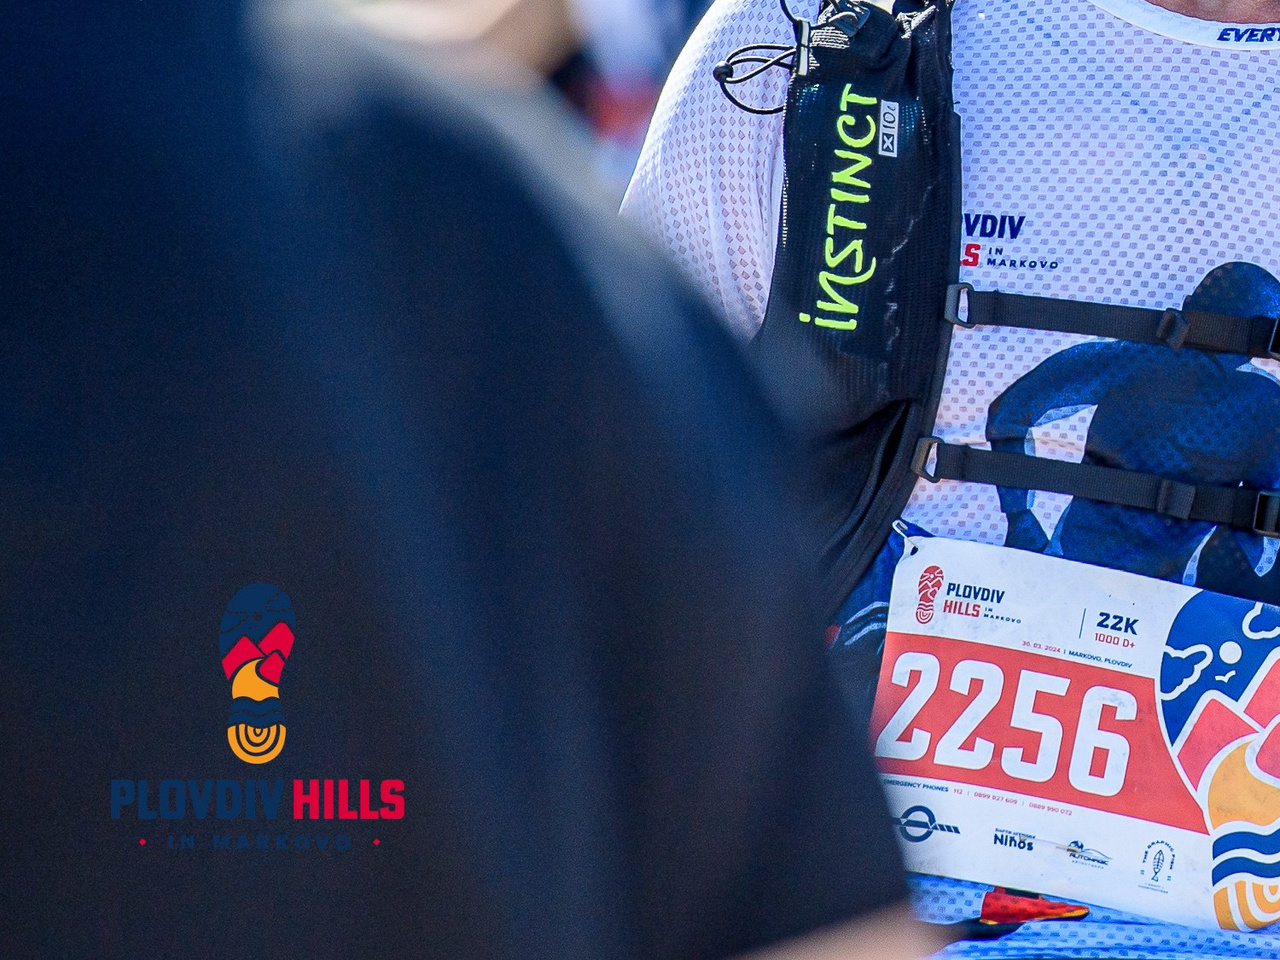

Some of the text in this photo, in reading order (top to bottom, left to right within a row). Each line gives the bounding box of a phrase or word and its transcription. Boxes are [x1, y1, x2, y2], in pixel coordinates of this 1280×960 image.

[962, 213, 1026, 239] VDIV
[960, 243, 1004, 267] S IN
[987, 258, 1059, 269] MARKOVO
[946, 582, 1005, 604] PLOVDIV
[943, 600, 981, 617] HILLS
[983, 613, 1022, 624] MARKOVO
[1096, 612, 1139, 636] 22K
[1094, 633, 1136, 648] 1000 D+
[1104, 657, 1133, 668] PLOVDIV
[874, 651, 1138, 797] 2256
[922, 783, 949, 793] PHONES
